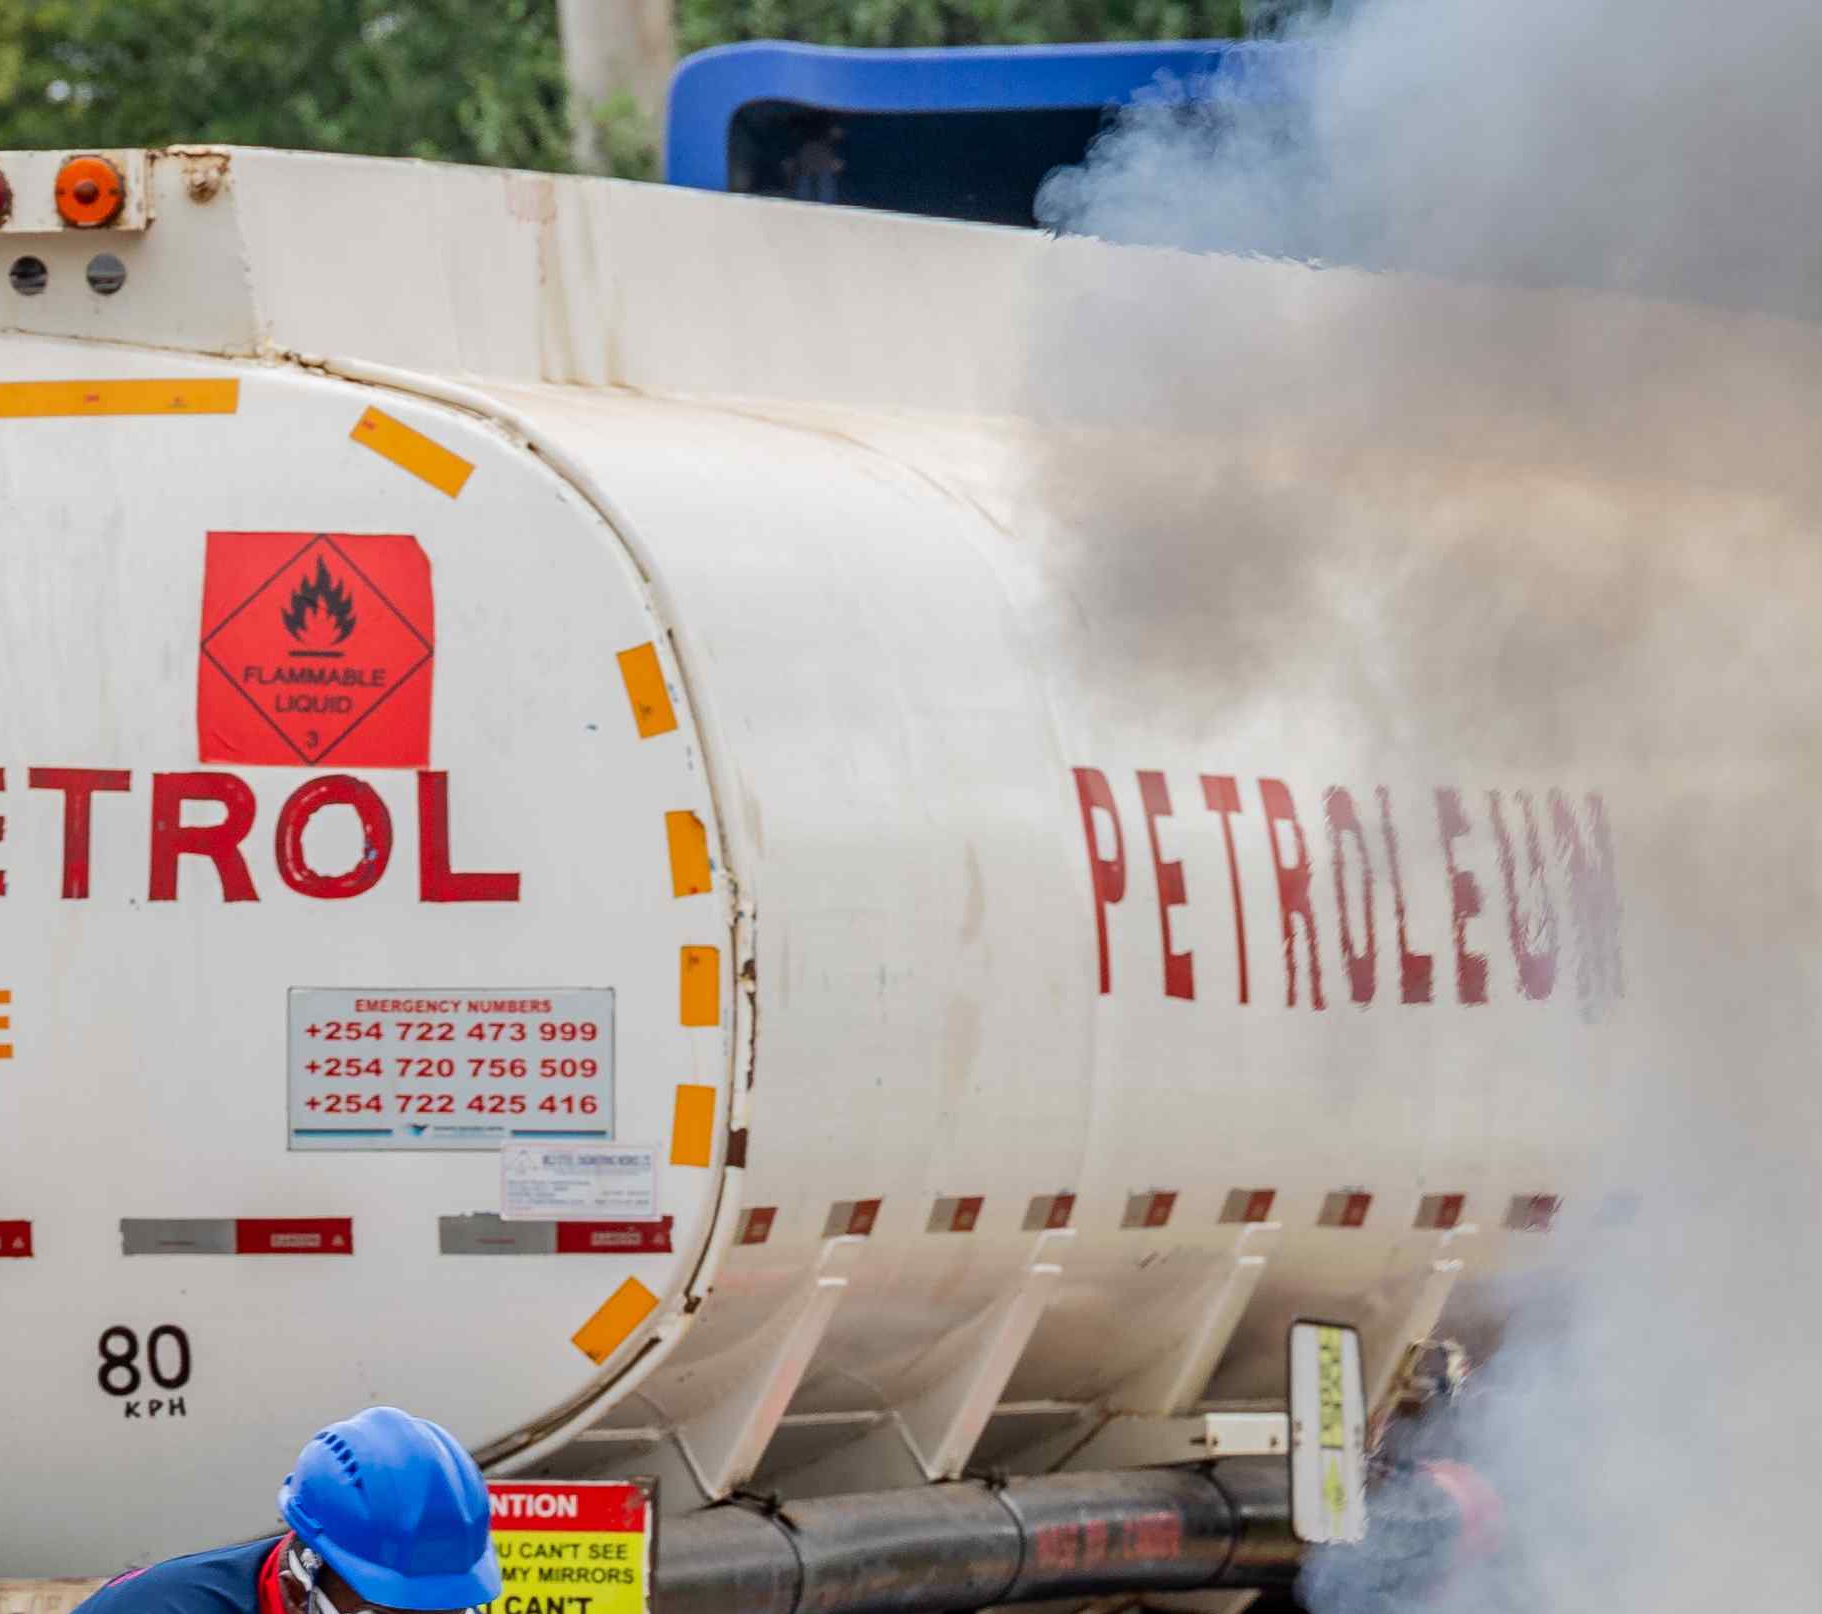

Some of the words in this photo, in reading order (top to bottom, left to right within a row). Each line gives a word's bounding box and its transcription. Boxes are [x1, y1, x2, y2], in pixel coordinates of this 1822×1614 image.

[243, 666, 386, 687] FLAMMABLE
[275, 695, 353, 714] LIQUID
[306, 730, 319, 749] 3
[355, 999, 461, 1014] EMERGENCY
[468, 999, 552, 1013] NUMBERS
[305, 1022, 383, 1041] +254
[395, 1022, 455, 1041] 722
[466, 1022, 527, 1041] 473
[539, 1022, 598, 1041] 999
[305, 1058, 383, 1078] +254
[395, 1058, 455, 1078] 720
[466, 1058, 527, 1078] 756
[539, 1058, 598, 1078] 509
[305, 1095, 383, 1114] +254
[395, 1095, 455, 1114] 722
[466, 1095, 527, 1114] 425
[539, 1095, 598, 1114] 416
[98, 1325, 191, 1396] 80
[124, 1397, 186, 1418] KPH
[490, 1494, 578, 1518] NTION
[519, 1544, 581, 1559] CAN'T
[588, 1544, 627, 1560] SEE
[502, 1567, 530, 1581] MY
[539, 1567, 634, 1584] MIRRORS
